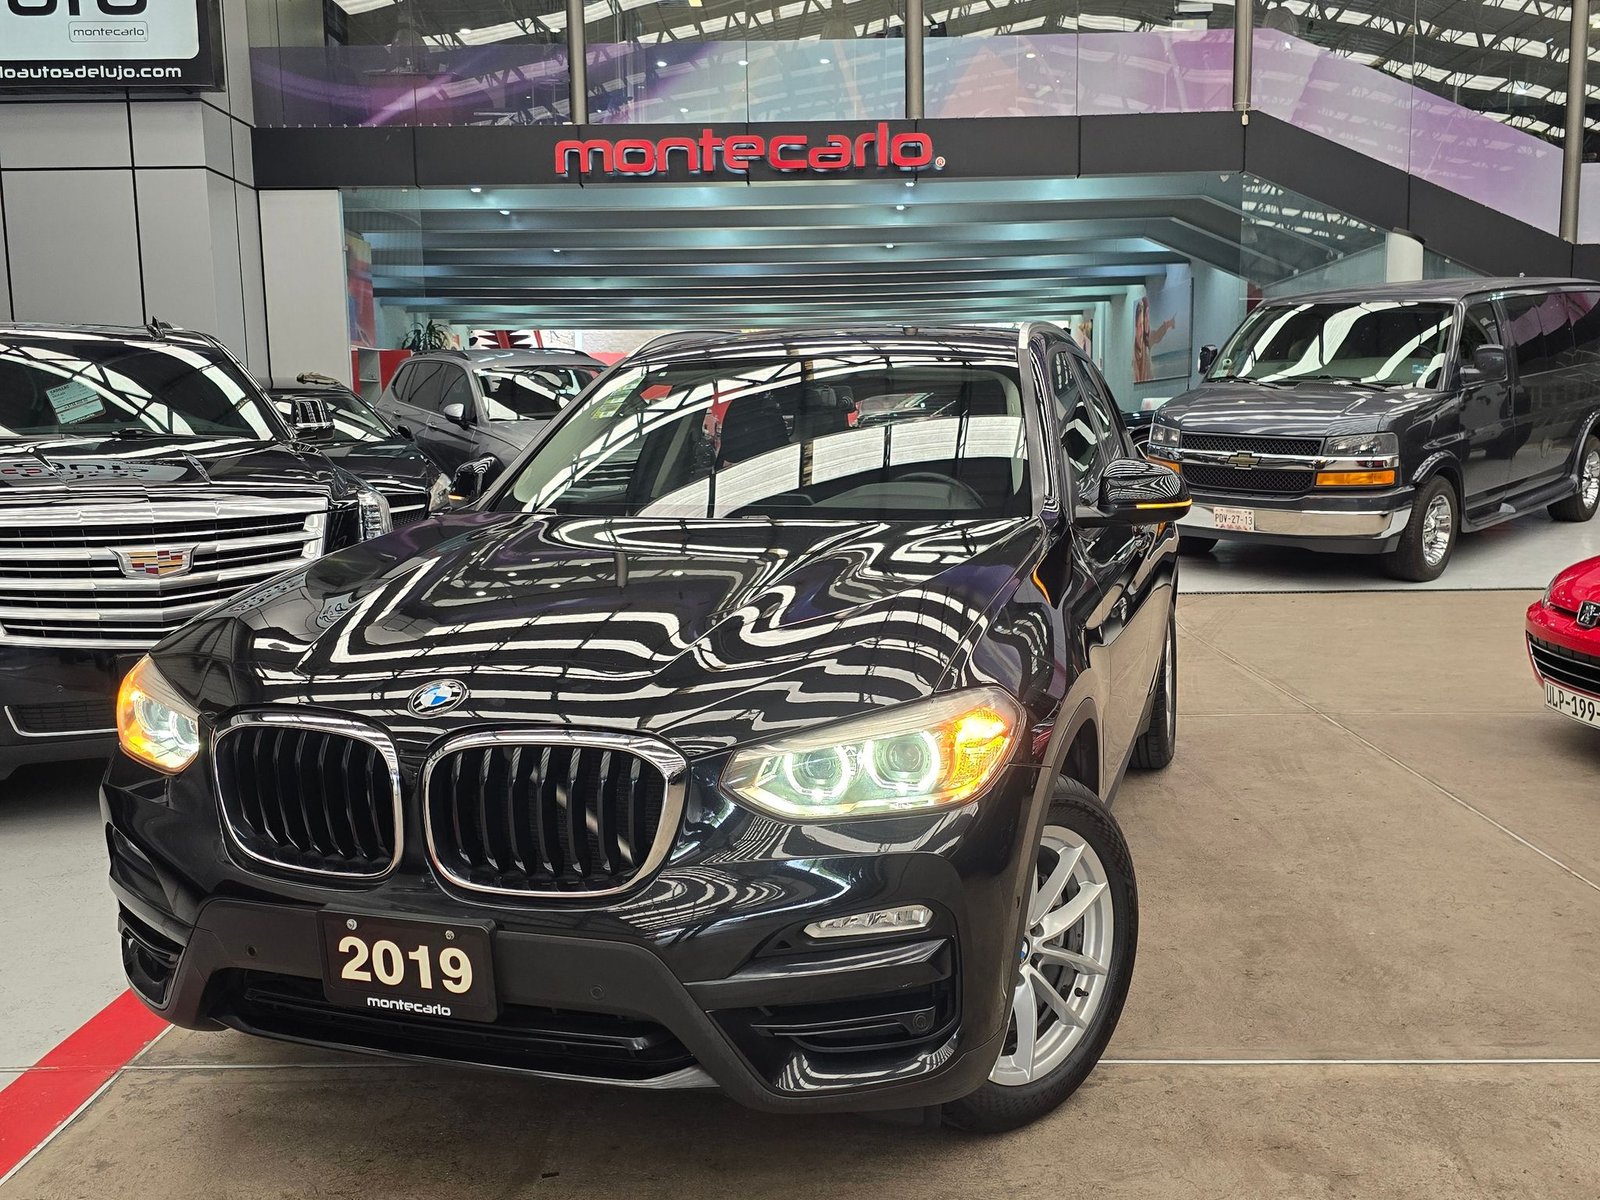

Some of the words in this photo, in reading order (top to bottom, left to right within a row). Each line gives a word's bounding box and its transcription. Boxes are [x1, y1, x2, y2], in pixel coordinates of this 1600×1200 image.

[73, 27, 145, 37] montecarlo
[554, 122, 934, 178] montecarlo
[338, 936, 473, 994] 2019
[366, 997, 452, 1017] montecarlo
